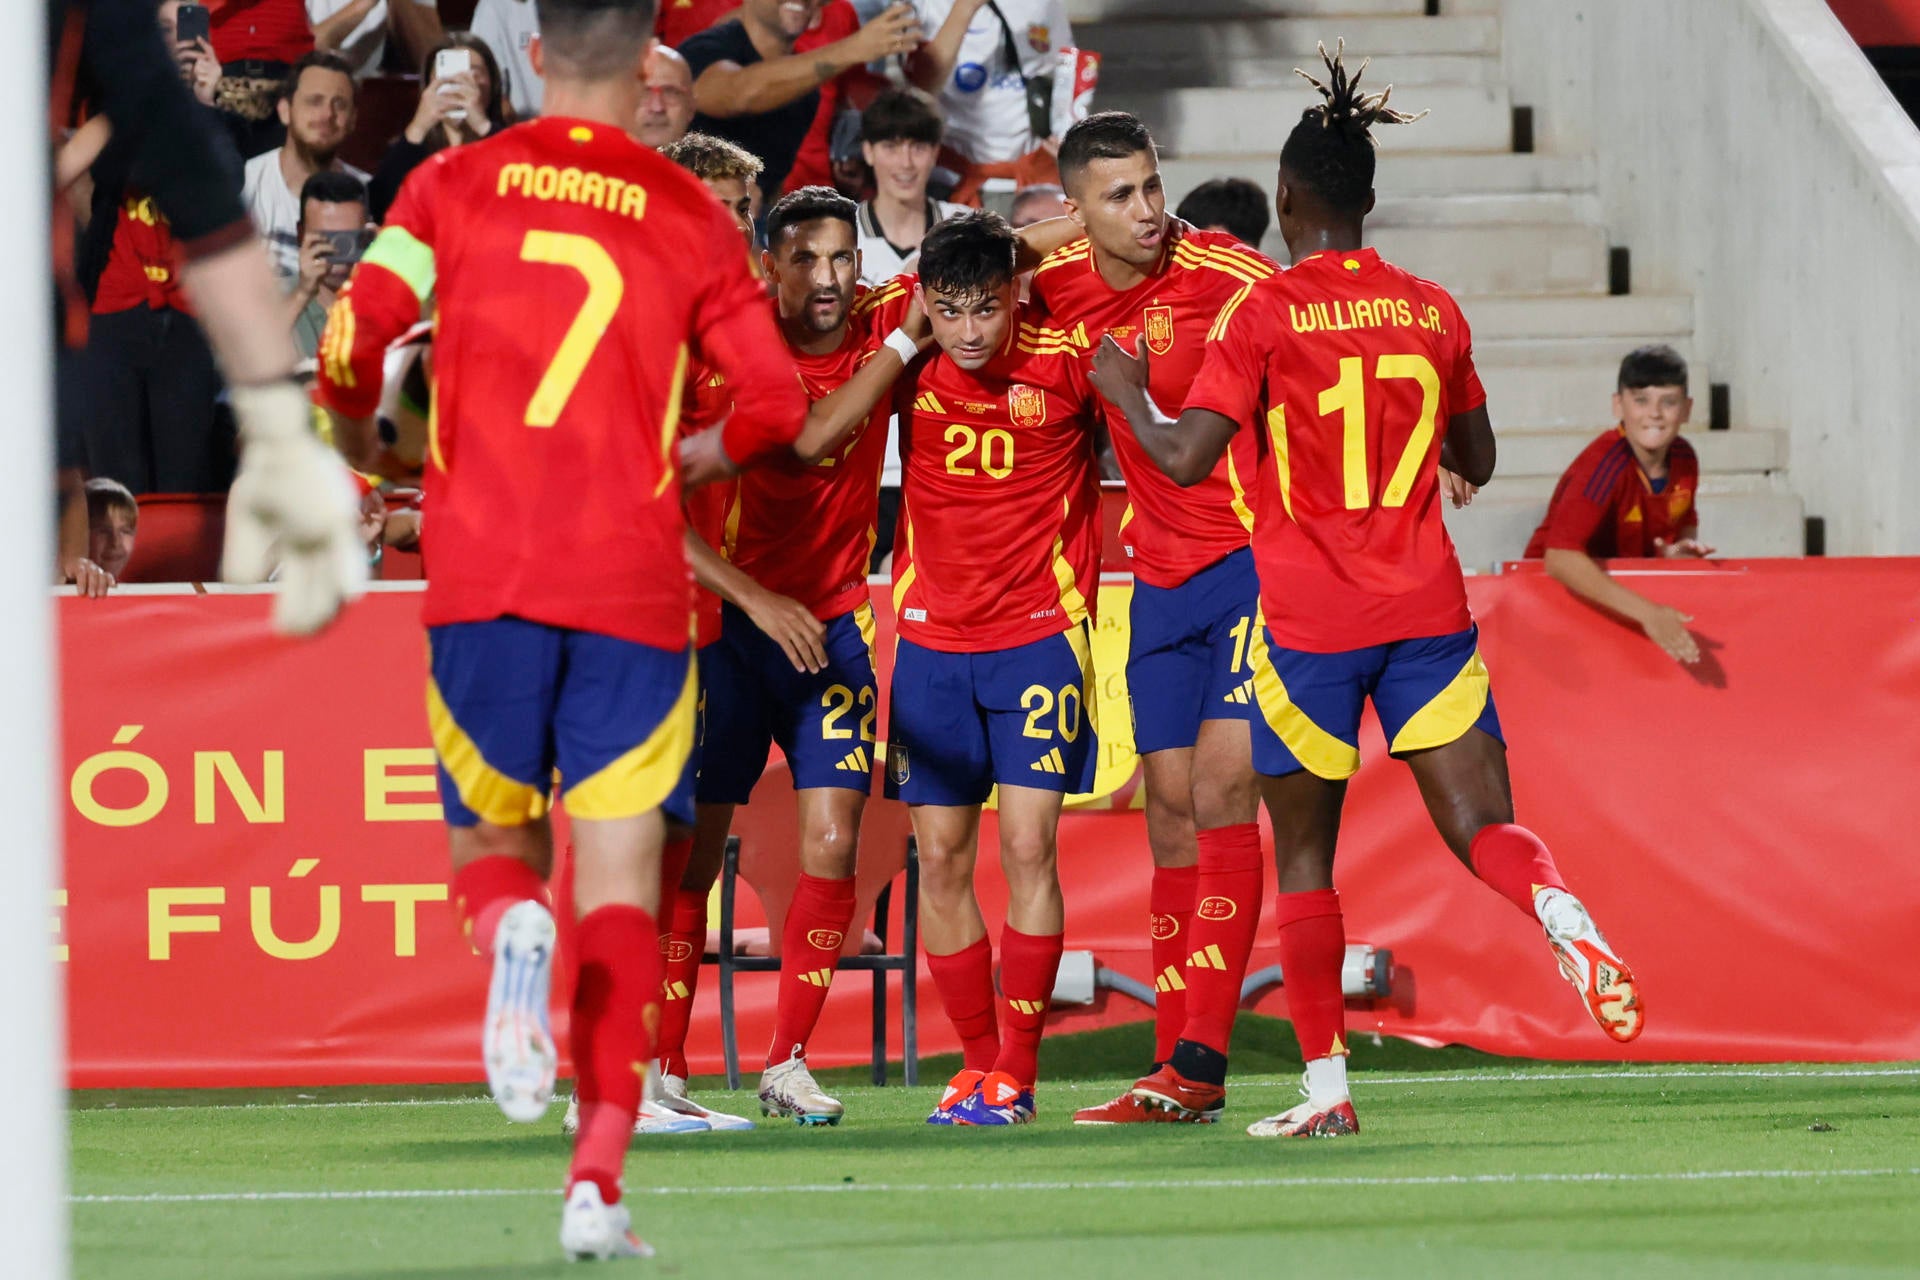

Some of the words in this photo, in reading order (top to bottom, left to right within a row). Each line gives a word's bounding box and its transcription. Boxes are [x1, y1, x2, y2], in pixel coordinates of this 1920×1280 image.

[497, 162, 648, 221] MORATA
[519, 229, 625, 428] 7
[1289, 298, 1413, 333] WILLIAMS
[1418, 303, 1448, 335] JR.
[944, 424, 1014, 480] 20
[1318, 354, 1440, 510] 17
[821, 684, 876, 743] 22
[1020, 684, 1080, 743] 20
[70, 724, 285, 827] ÓN
[147, 858, 449, 960] FÚT
